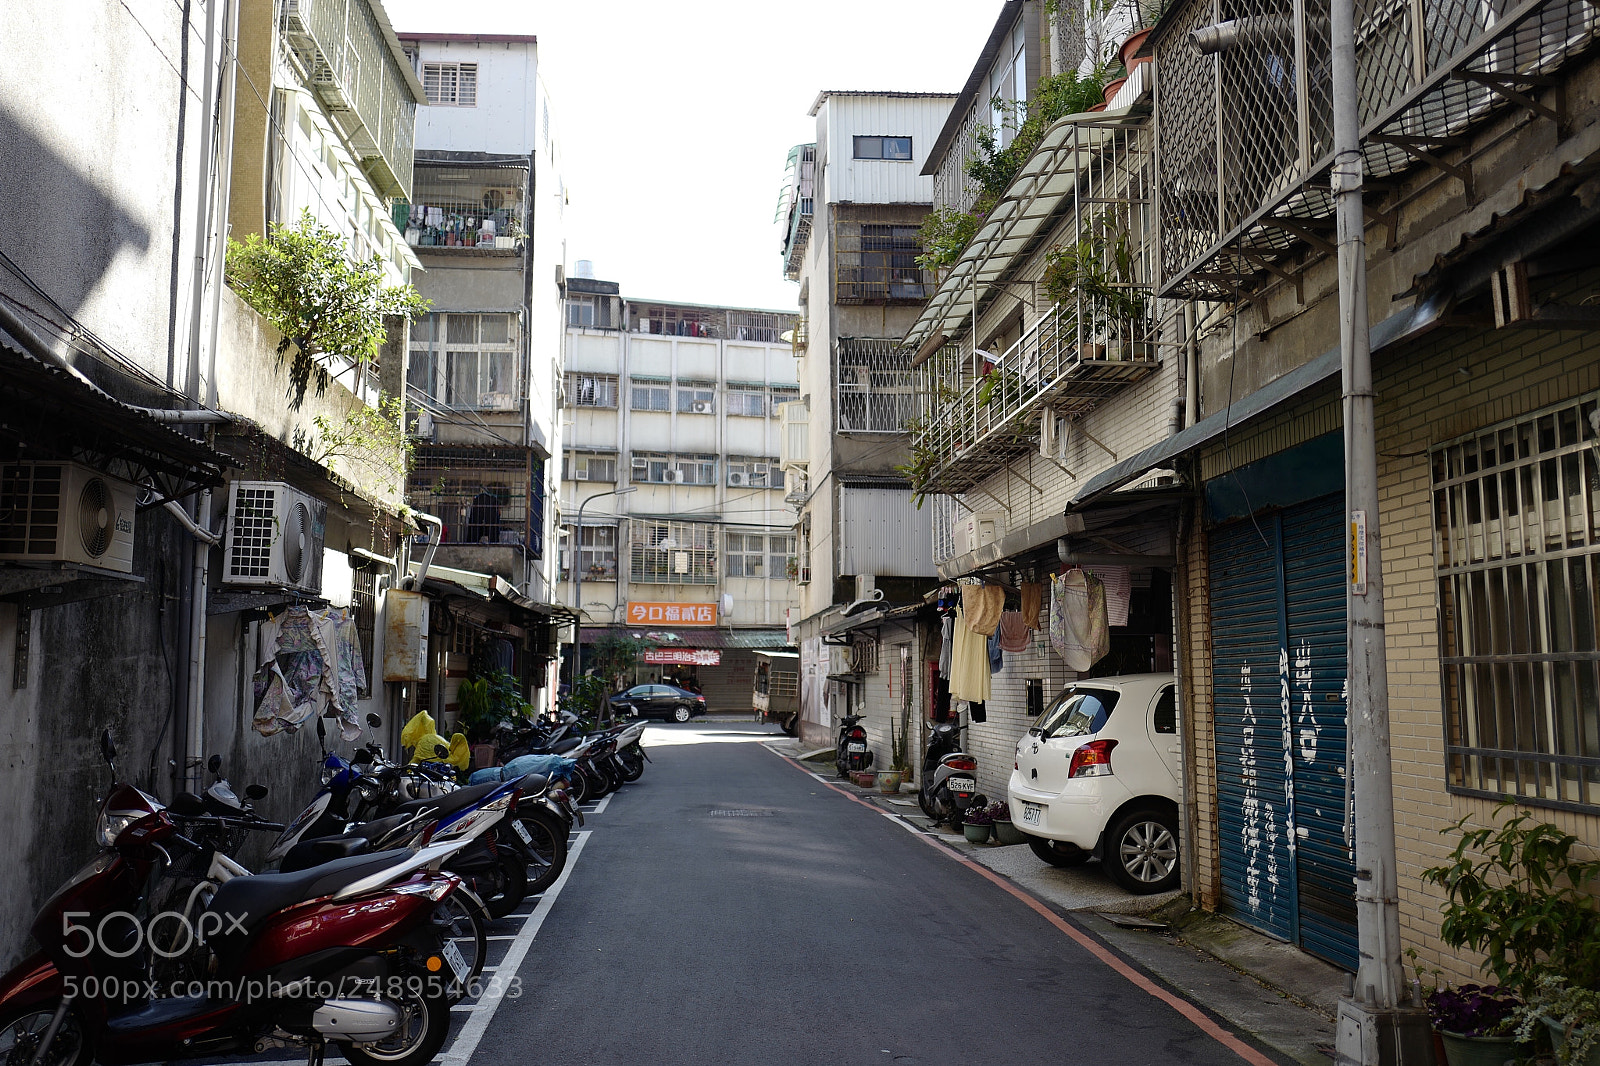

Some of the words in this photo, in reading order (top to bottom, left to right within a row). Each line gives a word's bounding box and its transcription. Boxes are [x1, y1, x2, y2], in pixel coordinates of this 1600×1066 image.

[645, 651, 691, 661] 古巴三明治
